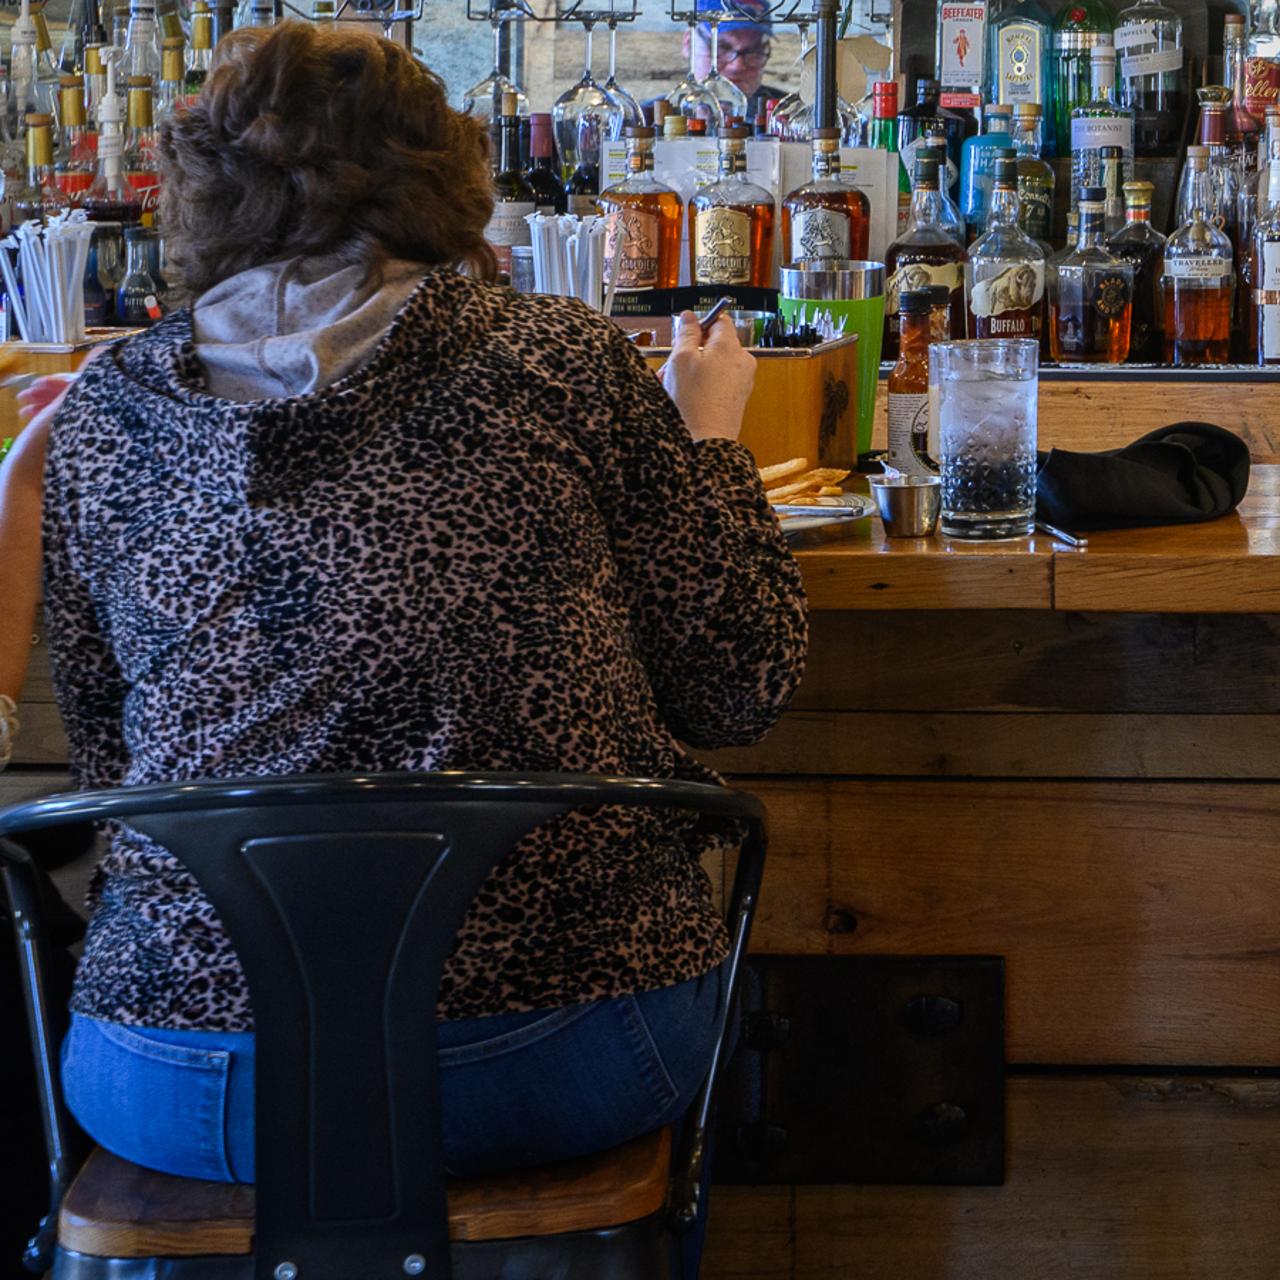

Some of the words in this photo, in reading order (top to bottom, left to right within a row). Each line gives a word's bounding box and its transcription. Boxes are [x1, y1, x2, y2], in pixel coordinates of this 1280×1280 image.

[943, 6, 984, 22] BEEFEATER
[1245, 79, 1280, 99] eller
[1087, 124, 1123, 132] BOTANIST
[1173, 259, 1223, 267] TRAVELLER
[990, 317, 1026, 334] BUFFALO
